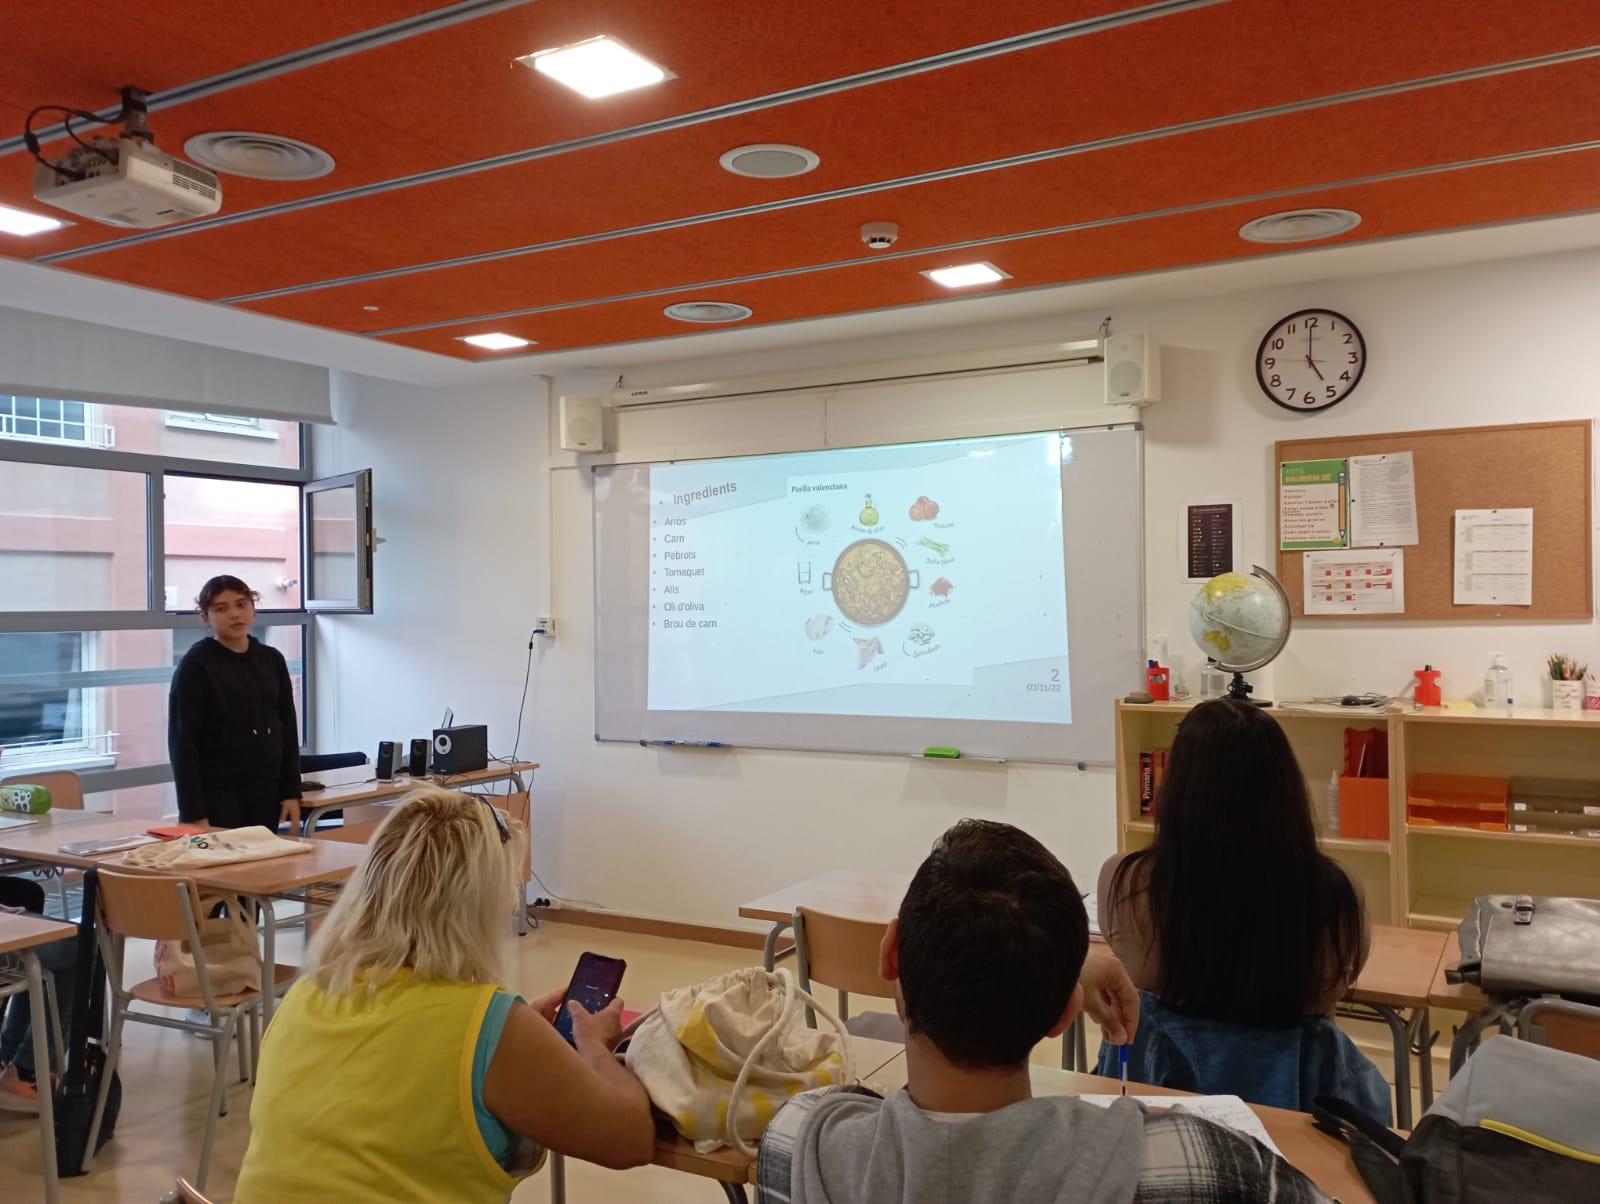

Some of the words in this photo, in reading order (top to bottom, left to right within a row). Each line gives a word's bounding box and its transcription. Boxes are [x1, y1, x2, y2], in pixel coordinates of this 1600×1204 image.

[1304, 317, 1318, 328] 12
[1331, 320, 1335, 331] 1
[1287, 324, 1296, 334] 11
[1271, 338, 1284, 350] 10
[1343, 333, 1353, 344] 2
[1265, 358, 1276, 369] 9
[1348, 352, 1358, 364] 3
[1270, 374, 1282, 387] 8
[1339, 371, 1351, 382] 4
[1286, 388, 1296, 400] 7
[1303, 391, 1316, 404] 6
[1326, 386, 1336, 398] 5
[812, 482, 848, 491] valenciana
[673, 482, 737, 505] Ingredients
[664, 534, 685, 543] Carn
[664, 550, 697, 560] Pebrots
[664, 568, 705, 579] Tomaquet
[664, 584, 680, 594] Alls
[664, 602, 675, 611] Oli
[677, 601, 705, 611] d'oliva
[664, 619, 684, 629] Brou
[685, 619, 697, 628] de
[698, 620, 718, 628] carn
[1050, 669, 1060, 682] 2
[1026, 683, 1062, 692] 03/11/22
